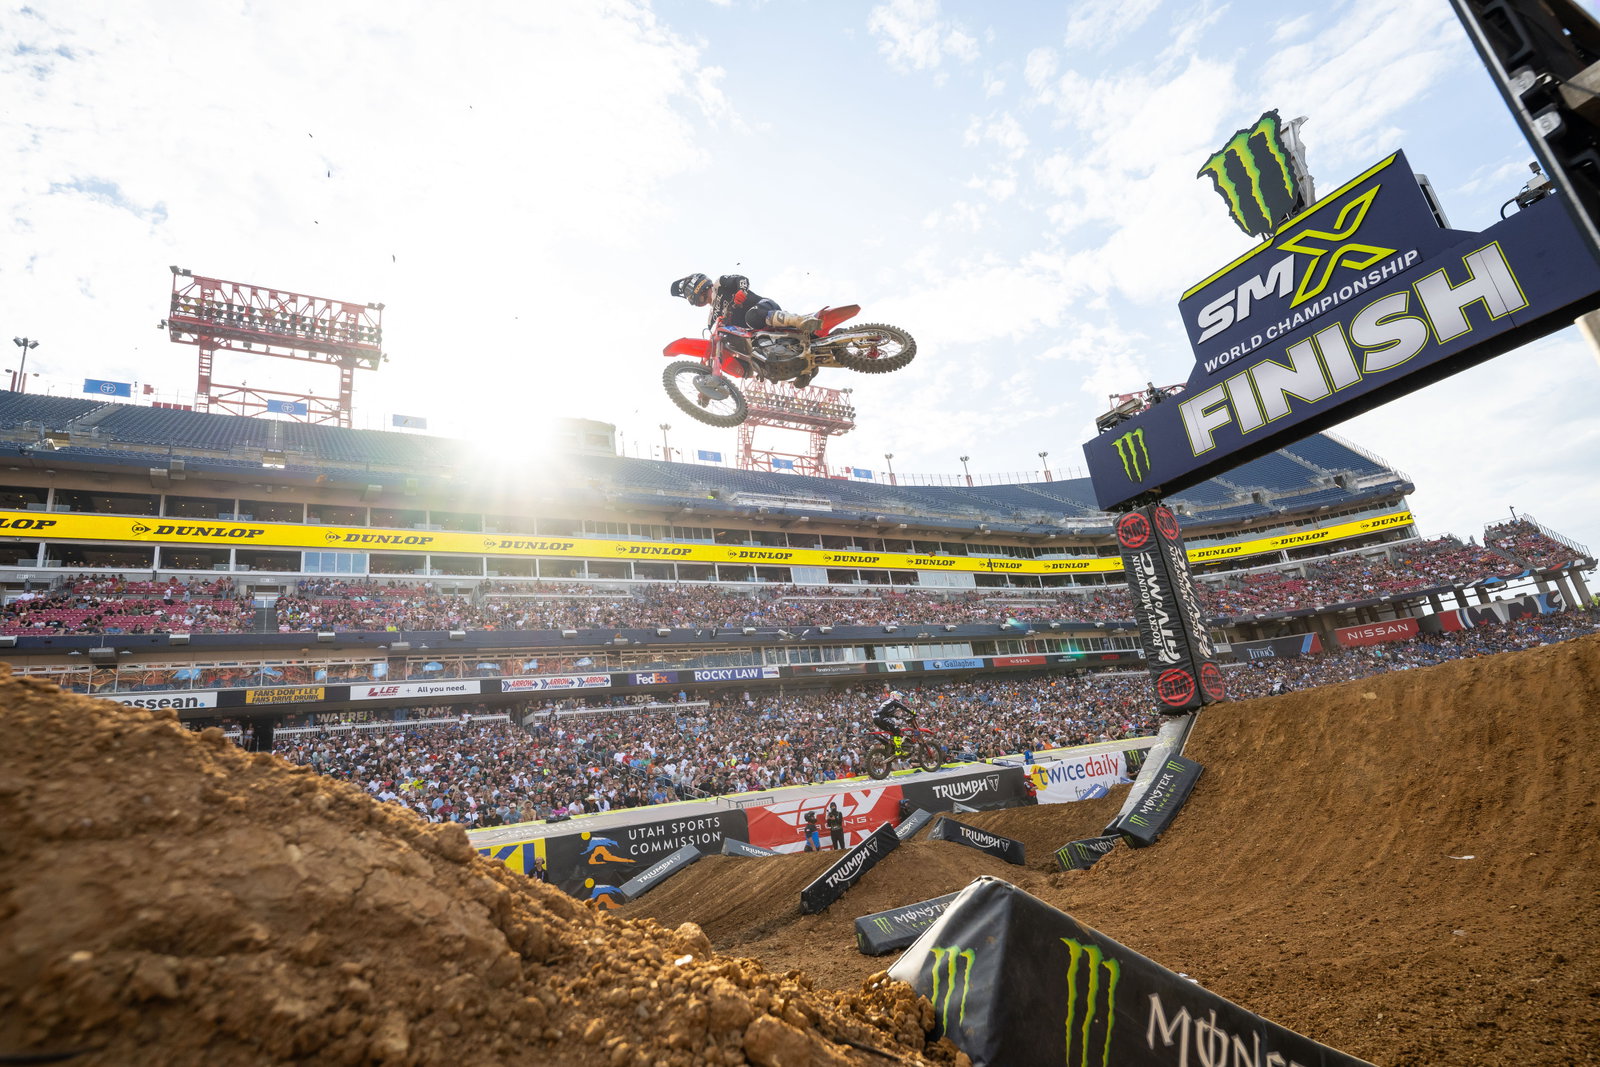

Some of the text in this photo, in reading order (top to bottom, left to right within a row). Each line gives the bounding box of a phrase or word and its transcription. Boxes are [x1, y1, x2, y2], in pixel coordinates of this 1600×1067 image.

[1197, 184, 1398, 345] SMX
[1204, 249, 1419, 373] WORLD CHAMPIONSHIP
[1178, 240, 1530, 458] FINISH
[153, 525, 265, 539] DUNLOP
[1280, 531, 1329, 546] DUNLOP
[343, 533, 434, 546] DUNLOP
[498, 540, 574, 551] DUNLOP
[628, 546, 692, 556] DUNLOP
[738, 550, 793, 560] DUNLOP
[1197, 546, 1242, 559] DUNLOP
[833, 554, 880, 564] DUNLOP
[915, 557, 956, 567] DUNLOP
[987, 561, 1023, 569] DUNLOP
[1051, 561, 1090, 570] DUNLOP
[1131, 555, 1164, 647] ROCKY MOUNTAIN
[1347, 622, 1410, 640] NISSAN
[944, 660, 976, 668] Gallagher
[636, 672, 668, 684] FedEx
[694, 669, 733, 681] ROCKY
[735, 668, 759, 678] LAW
[304, 687, 319, 695] LET
[380, 686, 400, 694] LEE
[430, 686, 444, 694] you
[446, 684, 467, 692] need.
[932, 775, 988, 802] TRIUMPH
[1140, 773, 1174, 815] MONSTER
[1155, 783, 1177, 812] ENERGY
[628, 816, 721, 841] UTAH SPORTS
[630, 832, 722, 856] COMMISSION
[960, 826, 1000, 849] TRIUMPH
[637, 858, 675, 884] TRIUMPH
[825, 847, 870, 887] TRIUMPH
